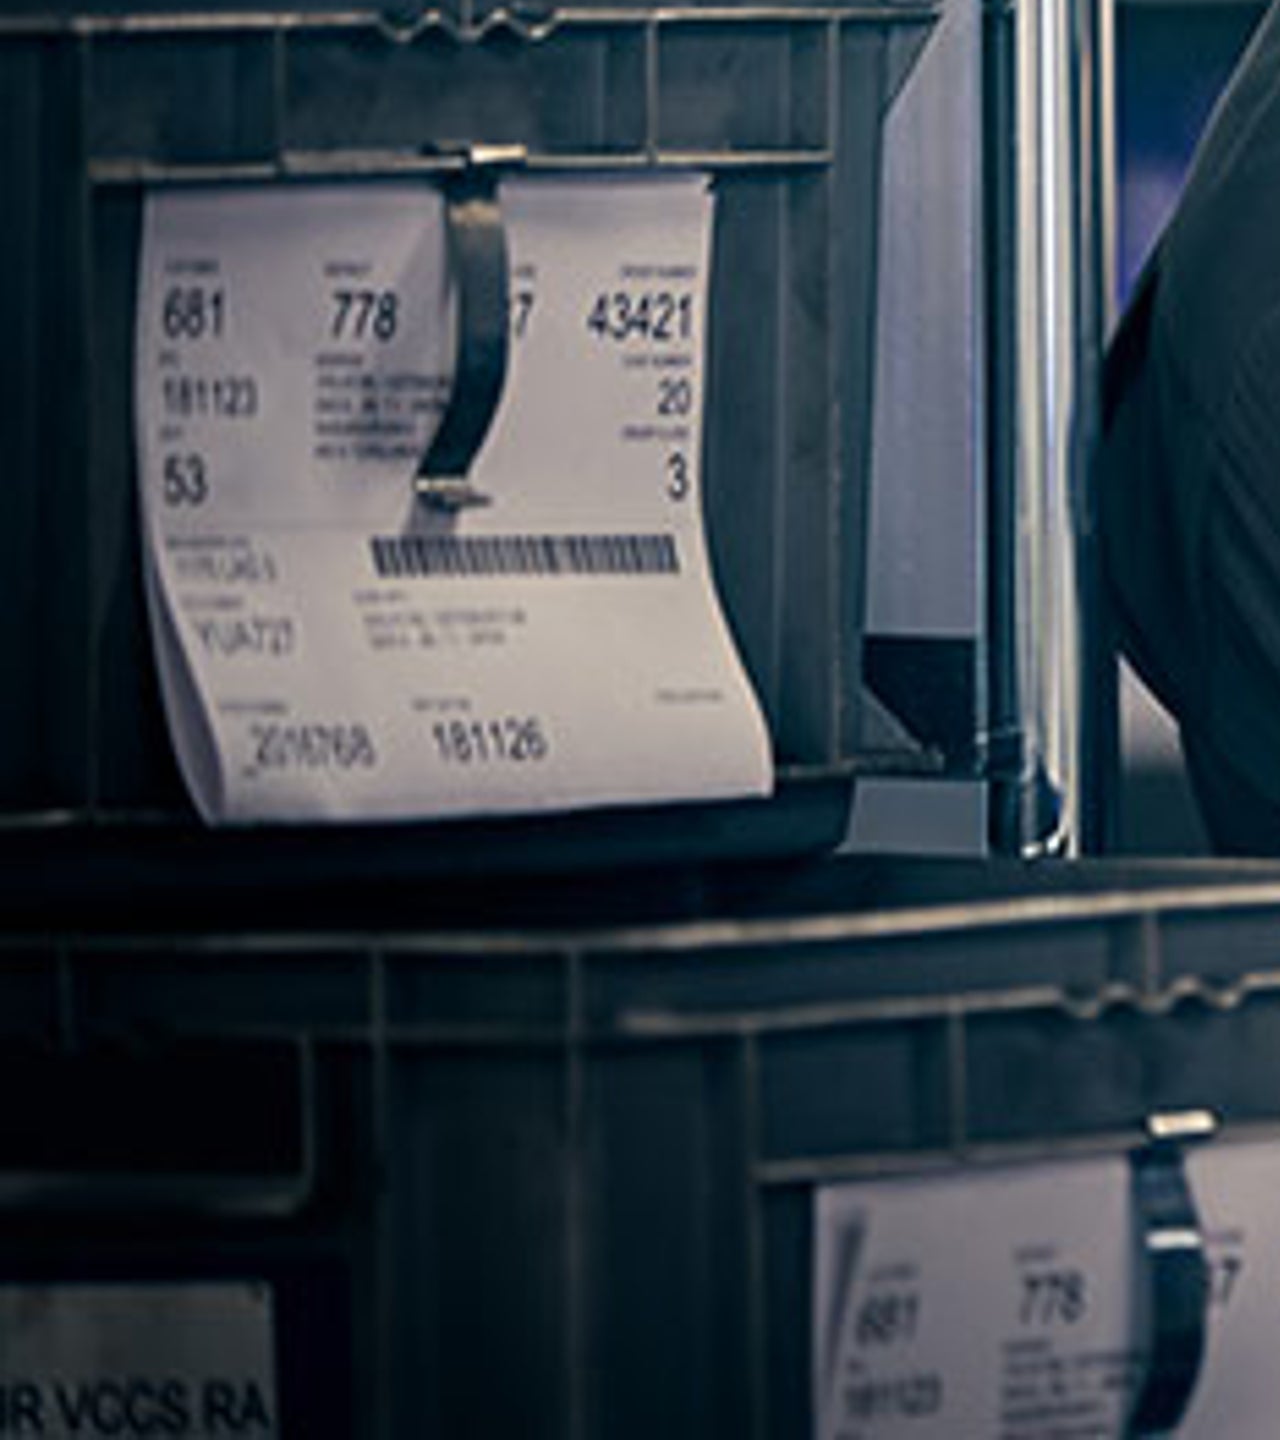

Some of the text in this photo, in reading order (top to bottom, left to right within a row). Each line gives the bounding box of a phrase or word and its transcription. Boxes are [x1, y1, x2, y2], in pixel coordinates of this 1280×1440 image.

[163, 289, 225, 339] 681
[330, 291, 398, 342] 778
[509, 292, 534, 337] 7
[586, 291, 693, 341] 43421
[162, 377, 258, 418] 181123
[656, 379, 691, 416] 20
[164, 455, 207, 506] 53
[667, 453, 688, 502] 3
[431, 719, 547, 762] 181126
[1020, 1271, 1084, 1323] 778
[53, 1377, 190, 1433] VCCS
[201, 1378, 270, 1431] RA
